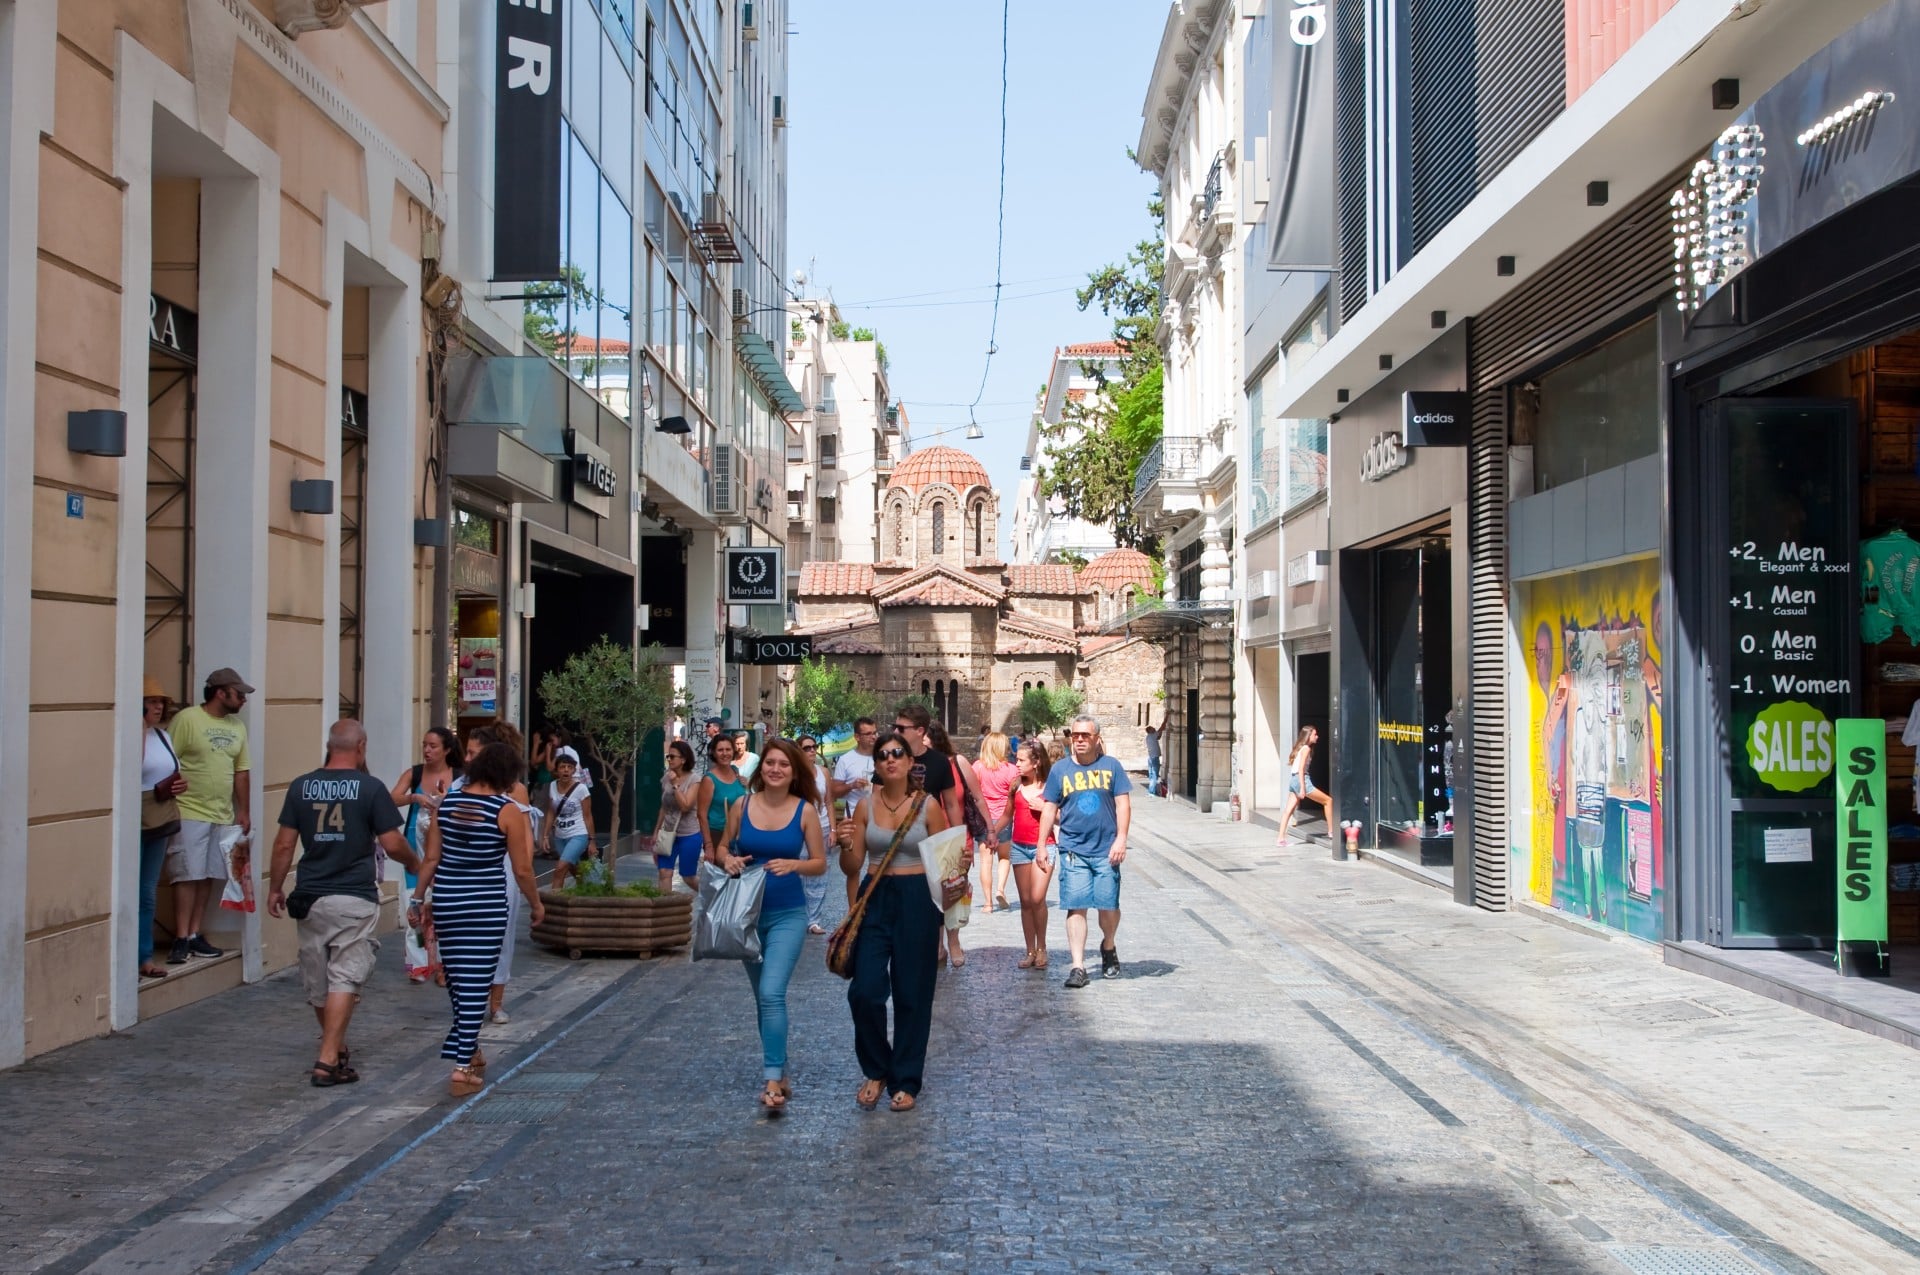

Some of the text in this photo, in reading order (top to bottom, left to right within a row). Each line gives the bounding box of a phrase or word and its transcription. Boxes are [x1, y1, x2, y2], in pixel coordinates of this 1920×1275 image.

[508, 0, 553, 95] R
[1413, 413, 1455, 424] adidas
[586, 454, 617, 497] TIGER
[72, 498, 80, 514] 47
[1778, 541, 1826, 561] Men
[748, 562, 760, 577] L
[1759, 561, 1805, 575] Elegant
[1809, 562, 1819, 573] &
[731, 586, 774, 597] Mary Lides
[1770, 585, 1816, 604] Men
[1773, 606, 1808, 616] Casual
[1771, 630, 1817, 650] Men
[754, 642, 810, 661] JOOLS
[1774, 650, 1814, 661] Basic
[1771, 674, 1851, 694] Women
[1753, 719, 1832, 773] SALES
[1431, 766, 1440, 774] M
[302, 780, 360, 800] LONDON
[312, 803, 345, 833] 74
[1844, 746, 1876, 902] SALES
